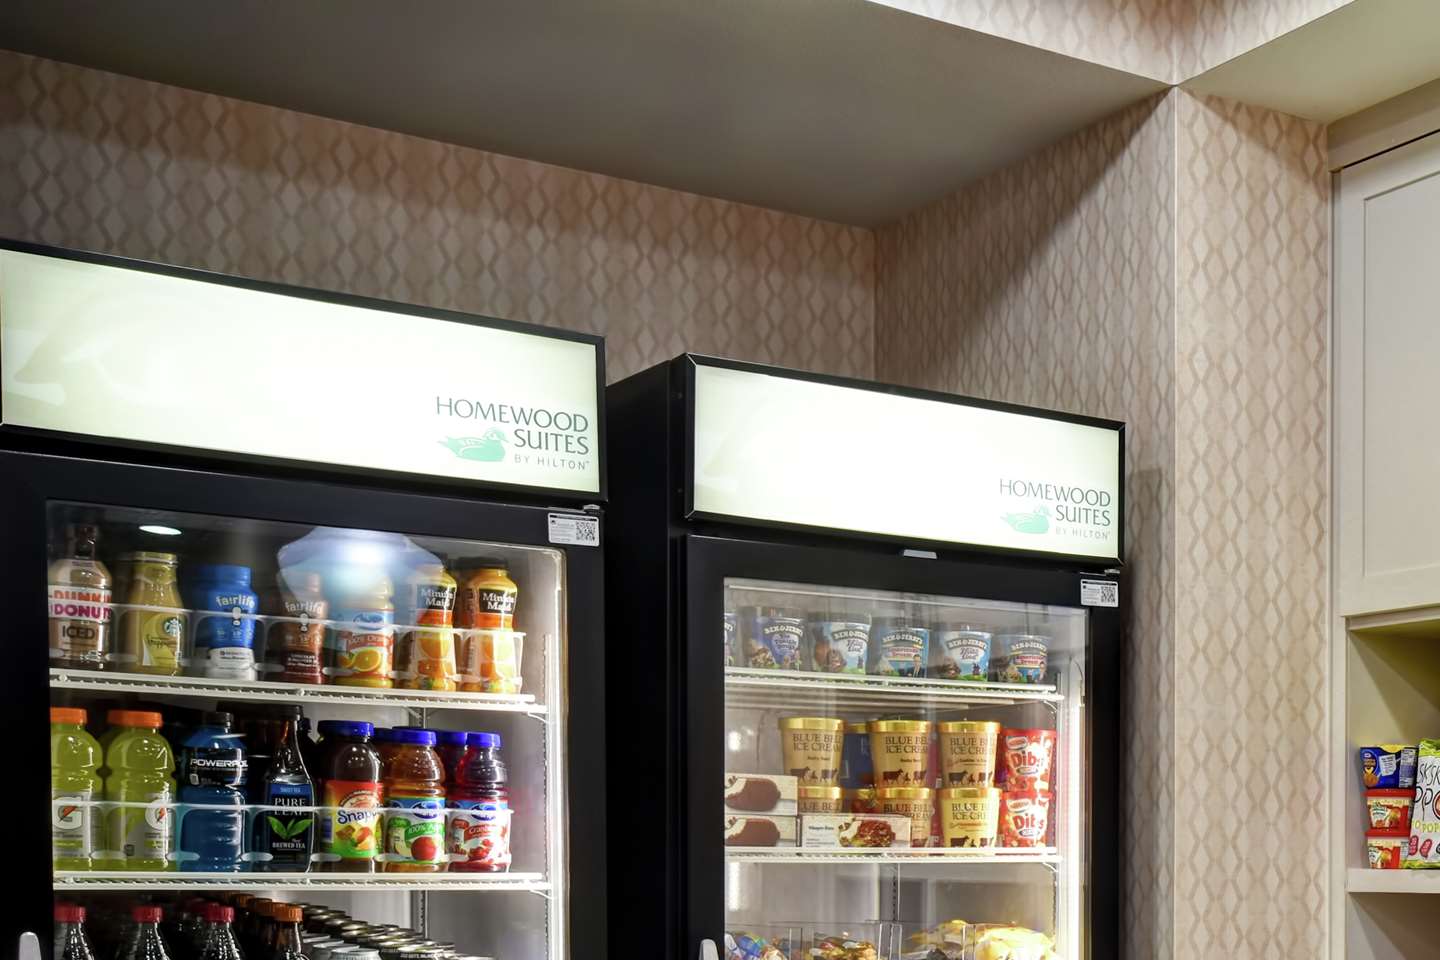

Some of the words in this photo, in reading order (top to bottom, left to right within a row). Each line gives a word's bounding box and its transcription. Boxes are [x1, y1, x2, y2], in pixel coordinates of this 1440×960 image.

[436, 395, 589, 433] HOMEWOOD
[514, 428, 589, 455] SUITES
[514, 454, 530, 464] BY
[537, 457, 586, 471] HILTON
[999, 478, 1111, 507] HOMEWOOD
[1056, 505, 1111, 527] SUITES
[62, 624, 95, 640] ICED
[792, 733, 820, 743] BLUE
[885, 736, 912, 745] BLUE
[950, 737, 977, 746] BLUE
[793, 742, 809, 751] ICE
[886, 745, 902, 753] ICE
[273, 796, 306, 808] PURE
[800, 802, 820, 812] LUE
[951, 802, 979, 812] BLUE
